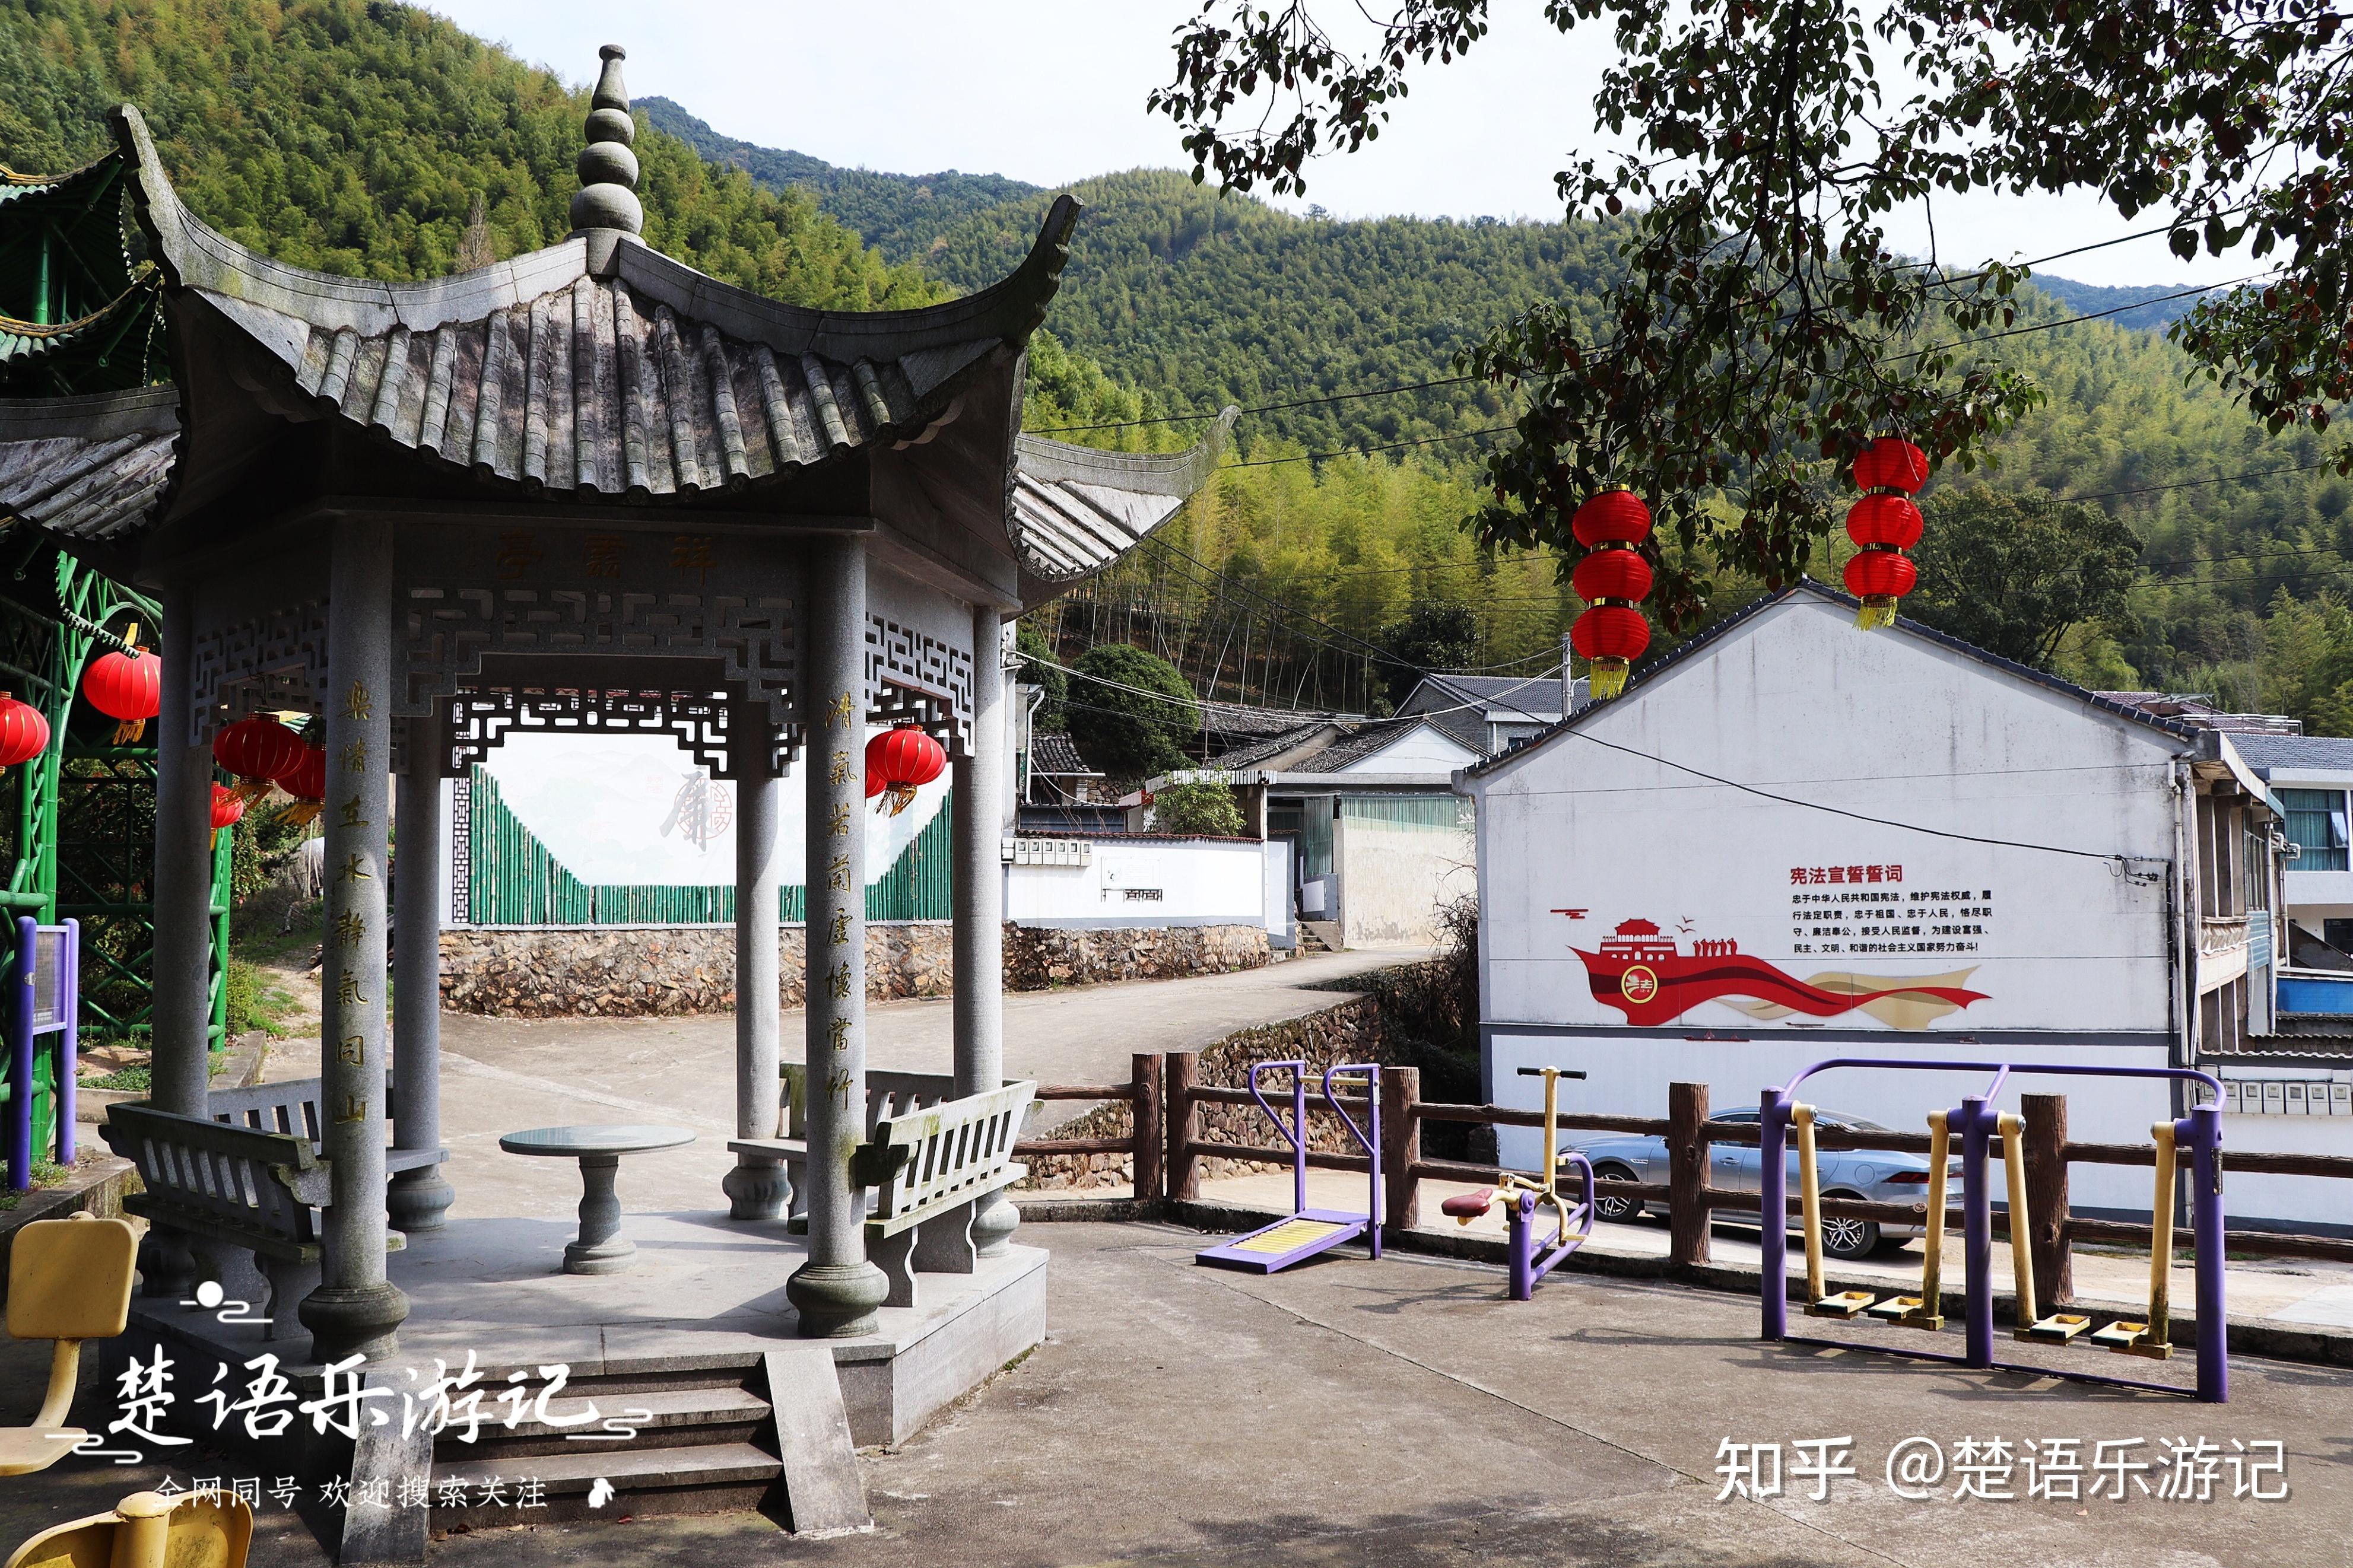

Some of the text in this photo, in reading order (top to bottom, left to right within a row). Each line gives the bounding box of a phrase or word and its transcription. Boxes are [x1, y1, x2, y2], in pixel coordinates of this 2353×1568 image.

[1790, 864, 1903, 885] 宪法宣誓誓词
